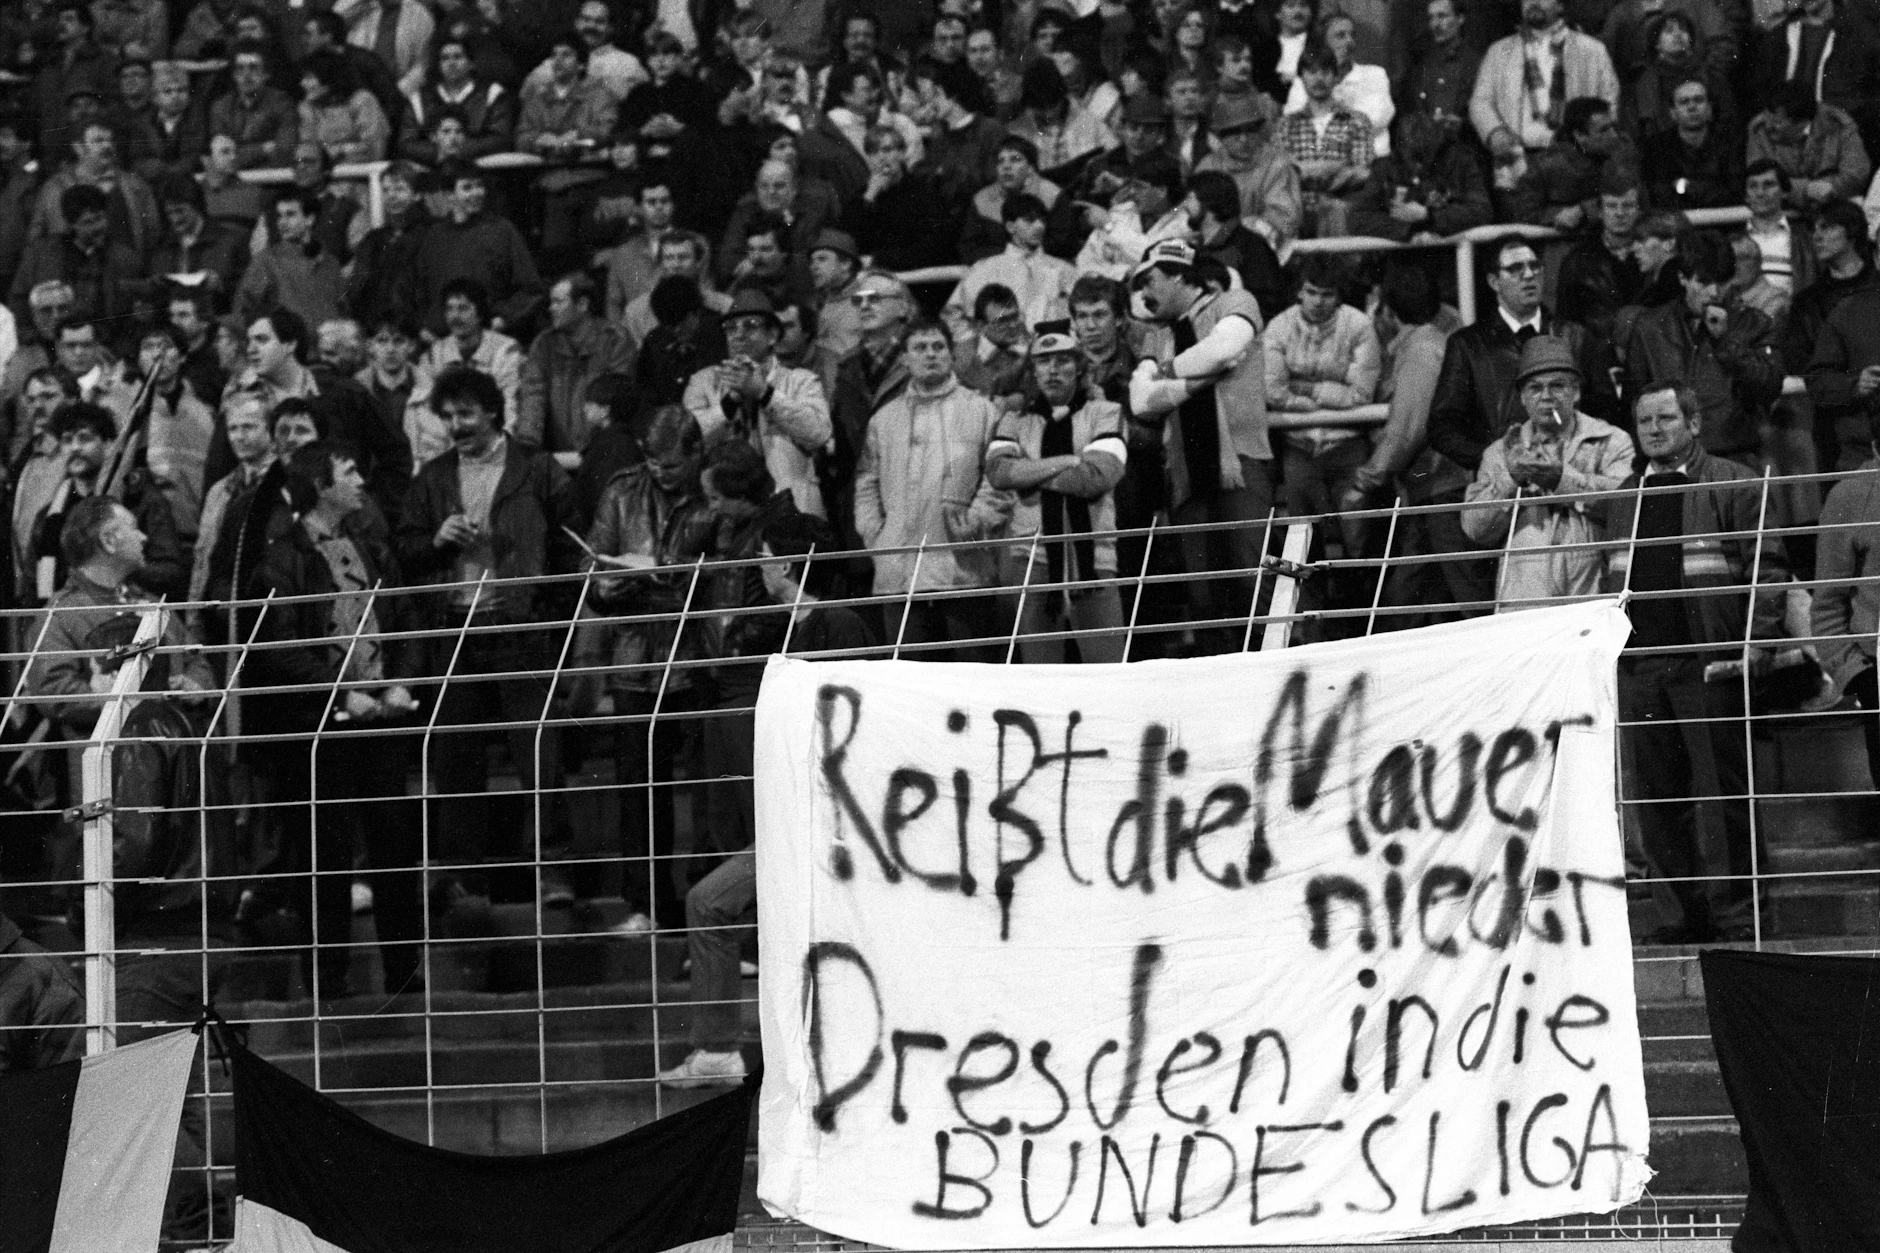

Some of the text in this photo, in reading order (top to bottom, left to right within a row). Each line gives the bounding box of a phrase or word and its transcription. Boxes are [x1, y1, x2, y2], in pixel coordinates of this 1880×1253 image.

[1106, 722, 1252, 893] die
[1303, 834, 1627, 957] nieder
[802, 938, 1611, 1136] Dresden in die
[911, 1082, 1633, 1230] BUNDESLIGA
